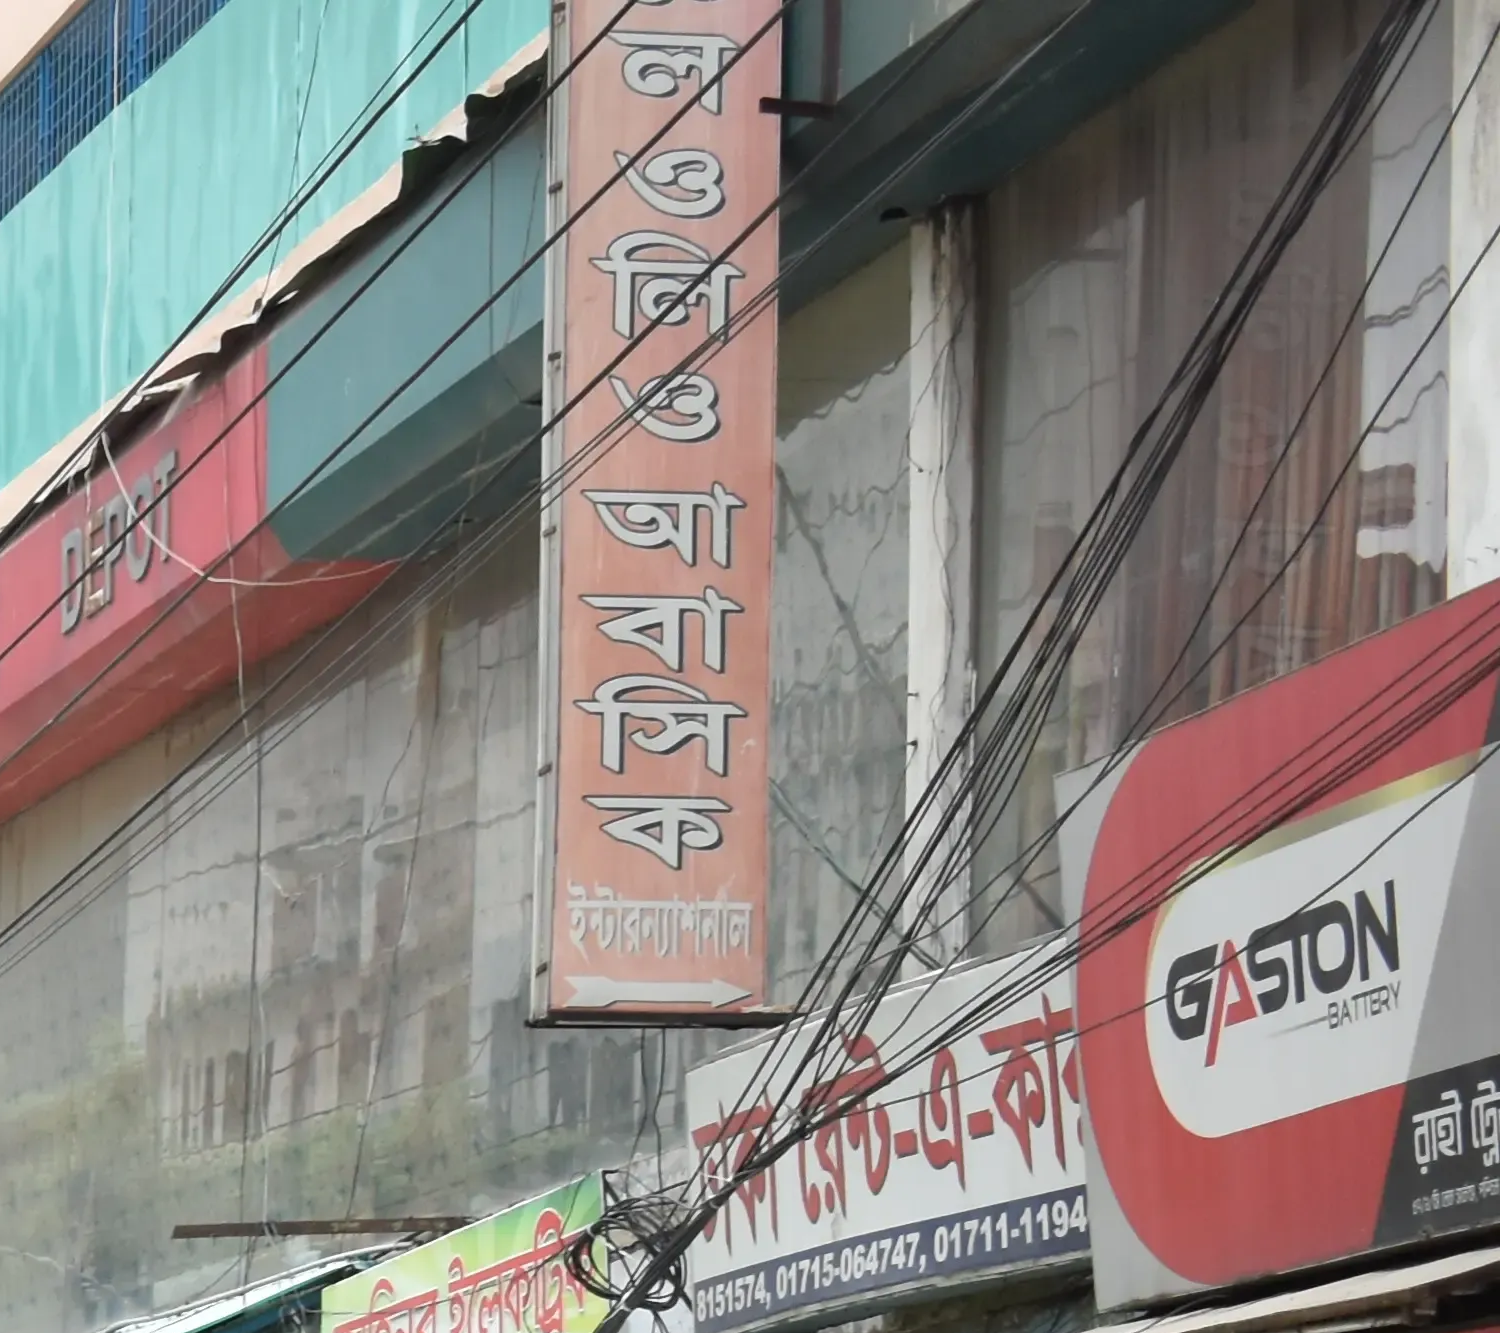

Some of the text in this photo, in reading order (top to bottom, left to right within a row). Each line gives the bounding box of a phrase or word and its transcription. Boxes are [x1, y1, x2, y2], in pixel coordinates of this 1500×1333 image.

[61, 450, 177, 635] DEPOT
[1165, 879, 1401, 1068] GASTON
[1327, 980, 1402, 1030] BATTERY
[696, 1195, 1088, 1323] 8151574, 01715-064747, 01711-1194
